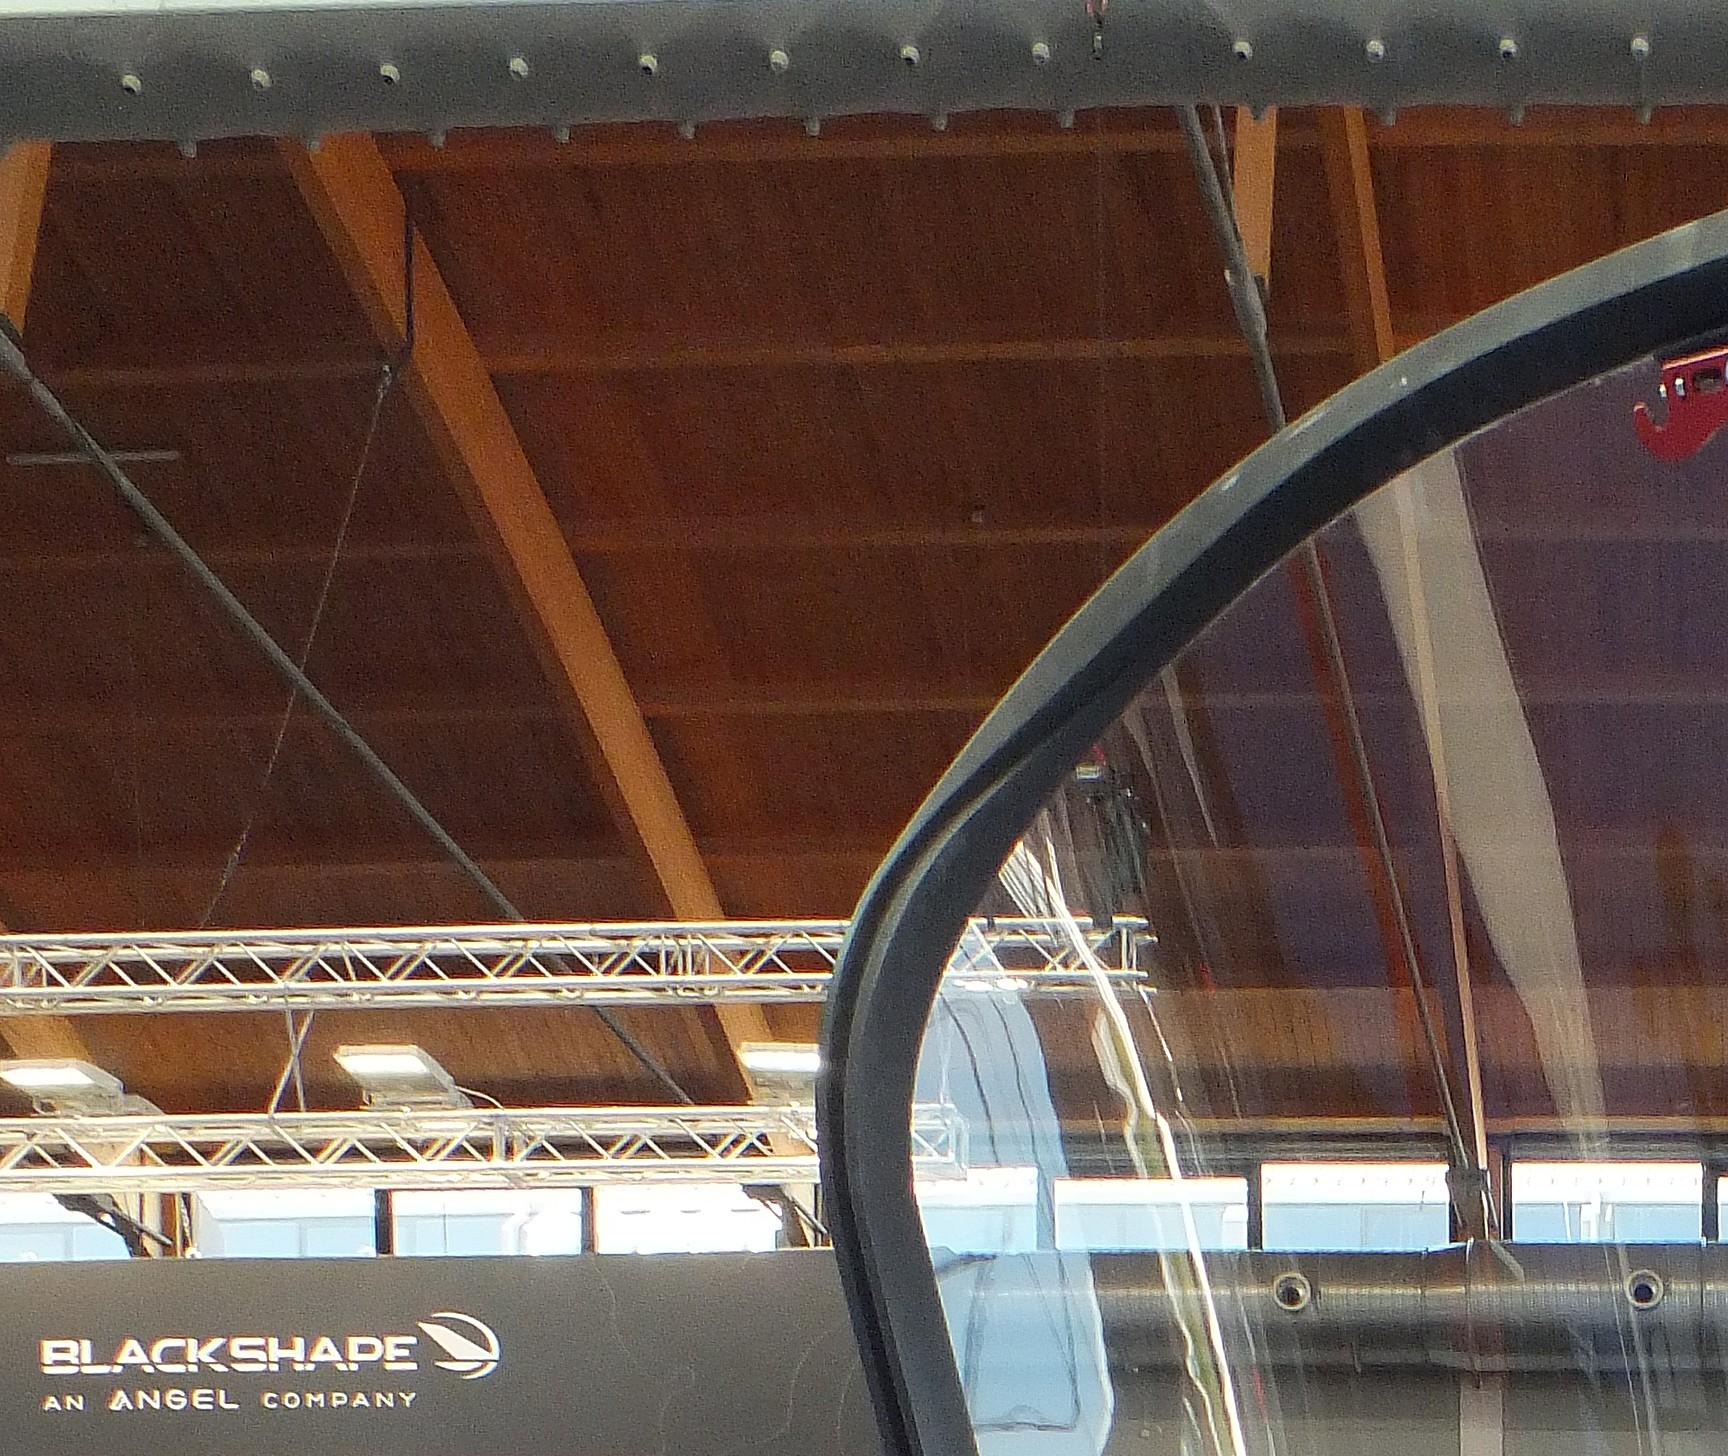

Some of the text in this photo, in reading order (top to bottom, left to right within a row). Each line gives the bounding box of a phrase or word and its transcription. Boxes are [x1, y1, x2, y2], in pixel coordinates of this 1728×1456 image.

[41, 1335, 419, 1375] BLACKSHAPE
[43, 1388, 418, 1411] AN ANGEL COMPANY
